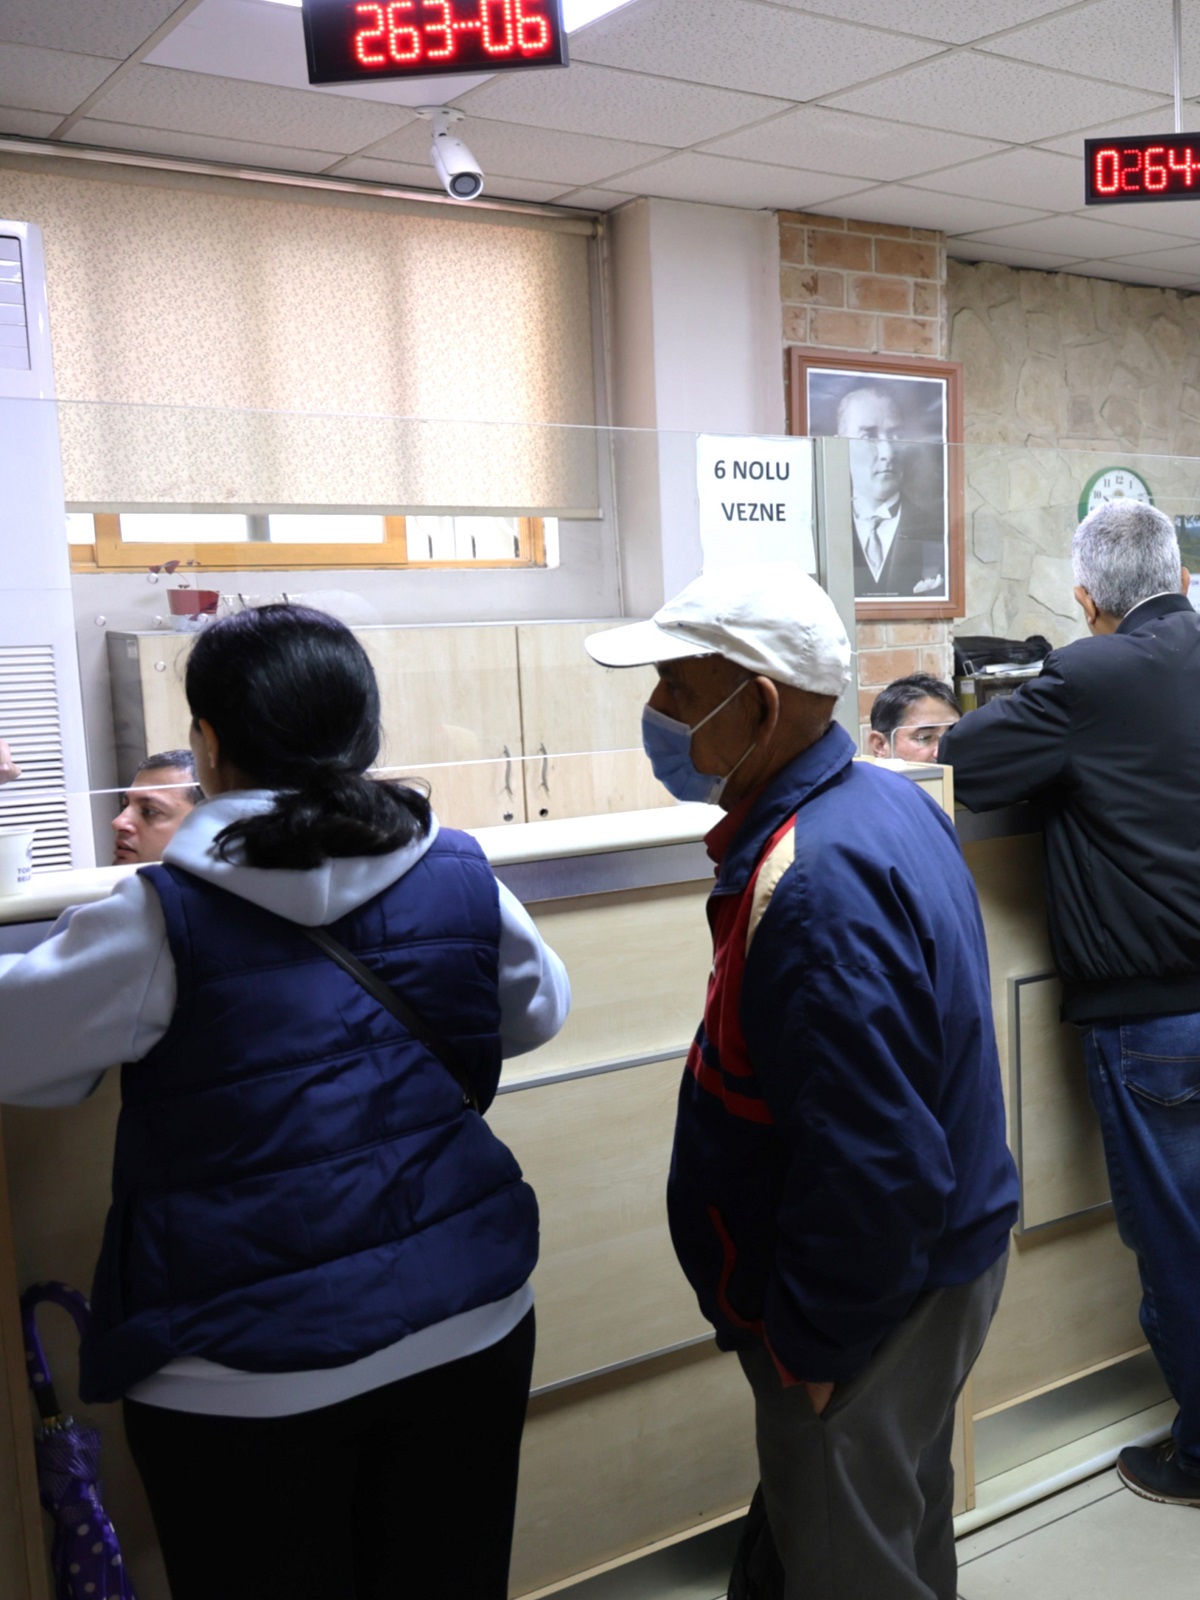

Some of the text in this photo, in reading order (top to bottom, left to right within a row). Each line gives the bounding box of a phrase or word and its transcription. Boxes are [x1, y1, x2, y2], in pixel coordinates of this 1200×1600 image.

[714, 459, 790, 481] 6 NOLU
[721, 502, 786, 522] VEZNE
